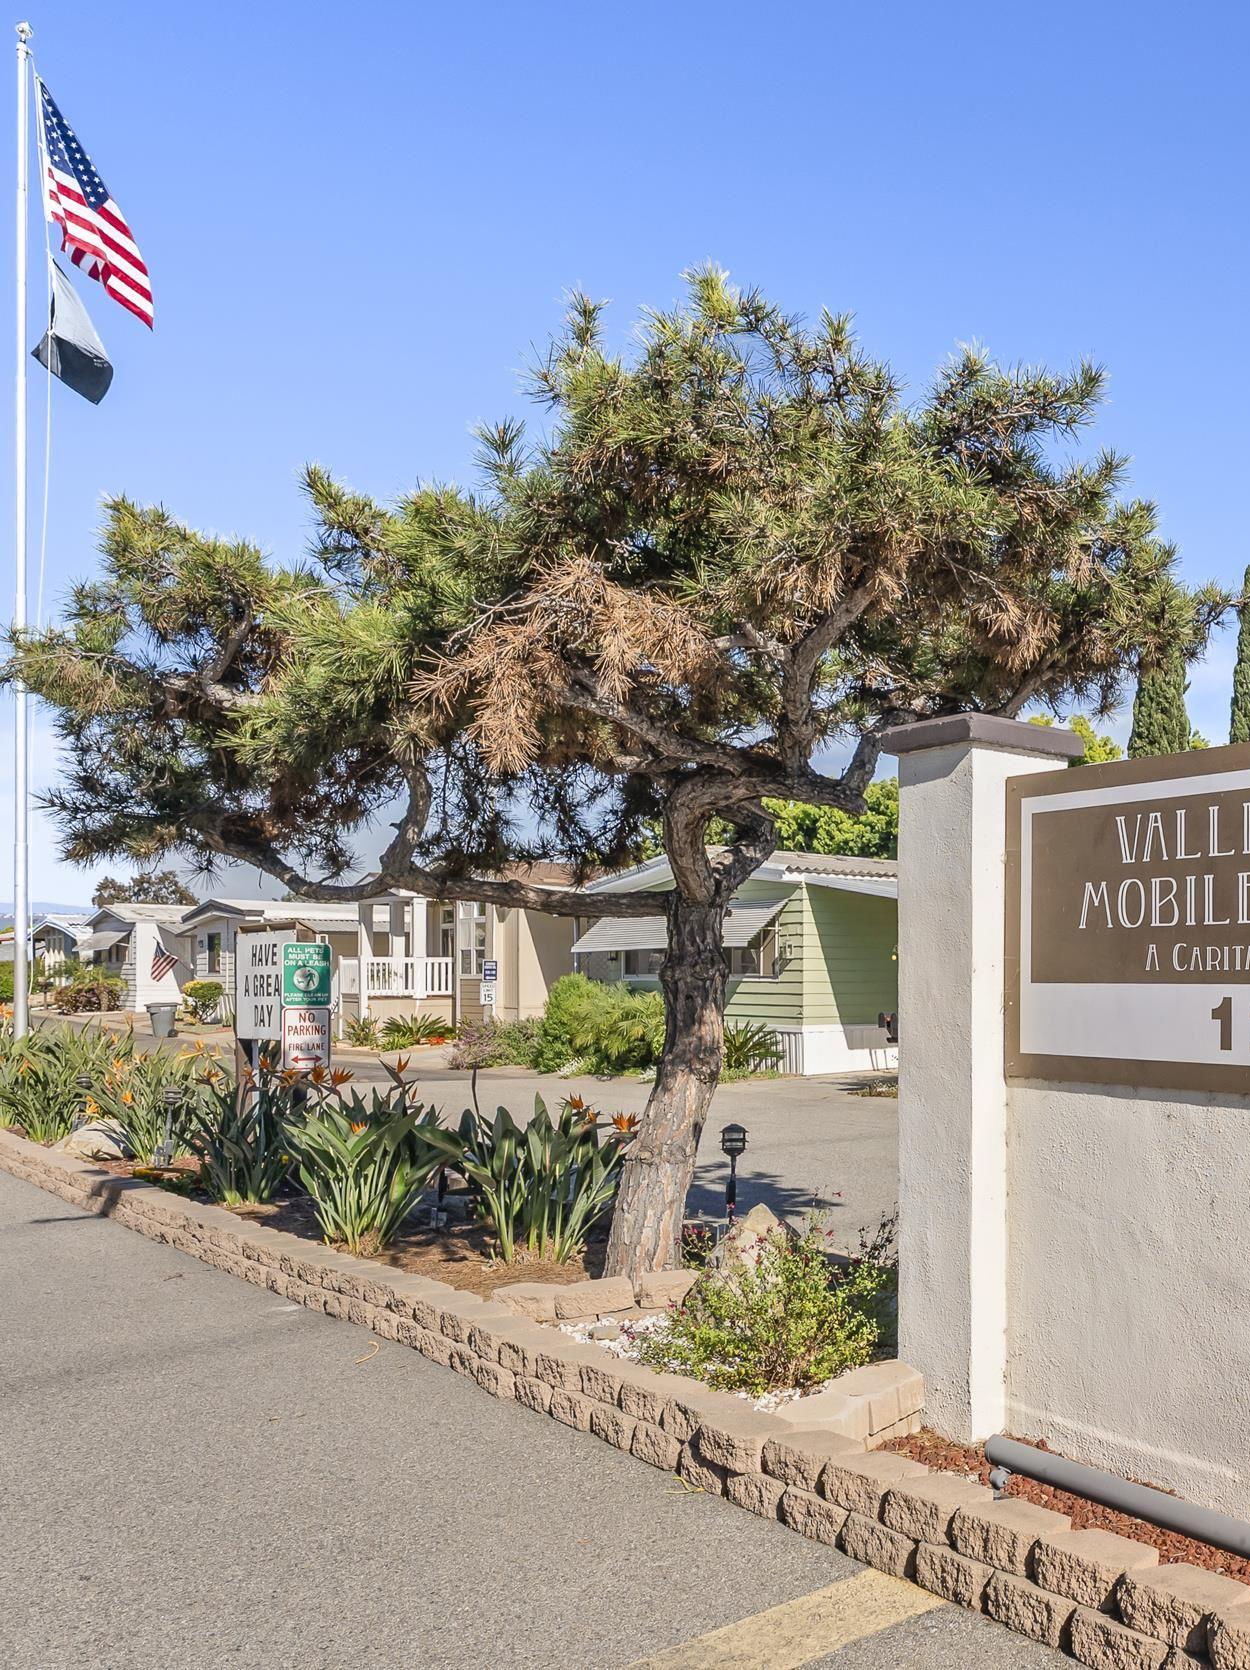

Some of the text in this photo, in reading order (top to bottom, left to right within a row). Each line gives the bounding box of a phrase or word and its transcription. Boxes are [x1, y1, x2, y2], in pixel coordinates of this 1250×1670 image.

[251, 943, 277, 967] HAVE
[1145, 944, 1160, 971] A
[244, 973, 282, 997] A GREA
[483, 993, 493, 1002] 15
[254, 1004, 273, 1028] DAY
[299, 1012, 316, 1023] NO
[287, 1025, 327, 1036] PARKING
[288, 1042, 326, 1051] FIRE LANE
